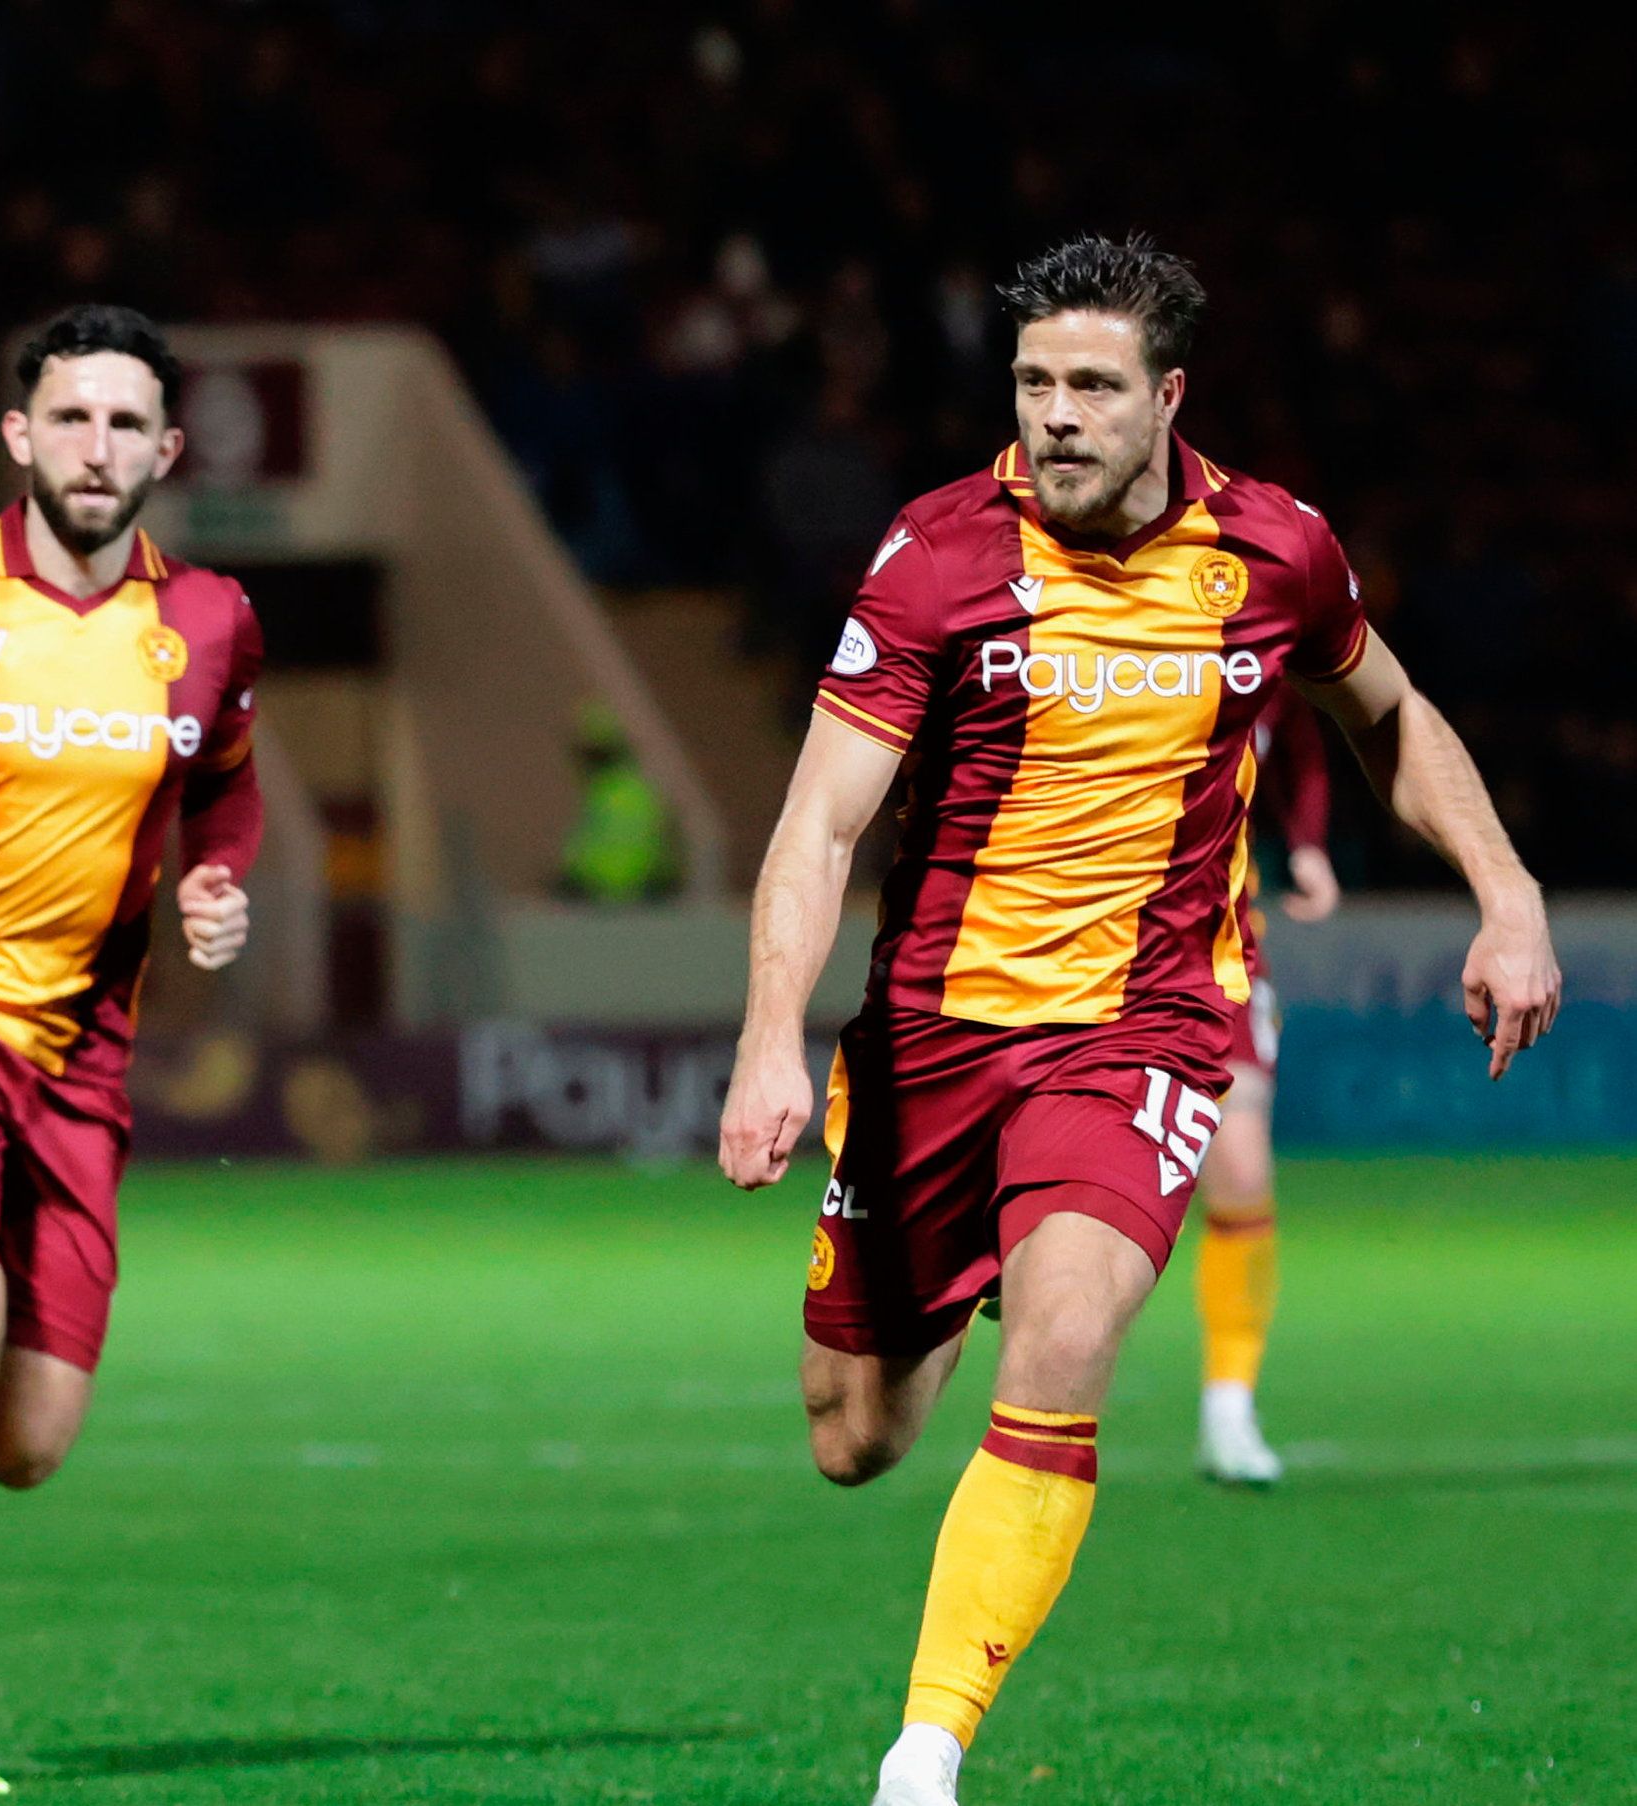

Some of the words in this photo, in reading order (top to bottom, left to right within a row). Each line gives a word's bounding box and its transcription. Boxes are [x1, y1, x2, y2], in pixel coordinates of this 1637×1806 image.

[981, 641, 1262, 714] Paycare
[1131, 1066, 1222, 1179] 15
[822, 1178, 868, 1219] CL
